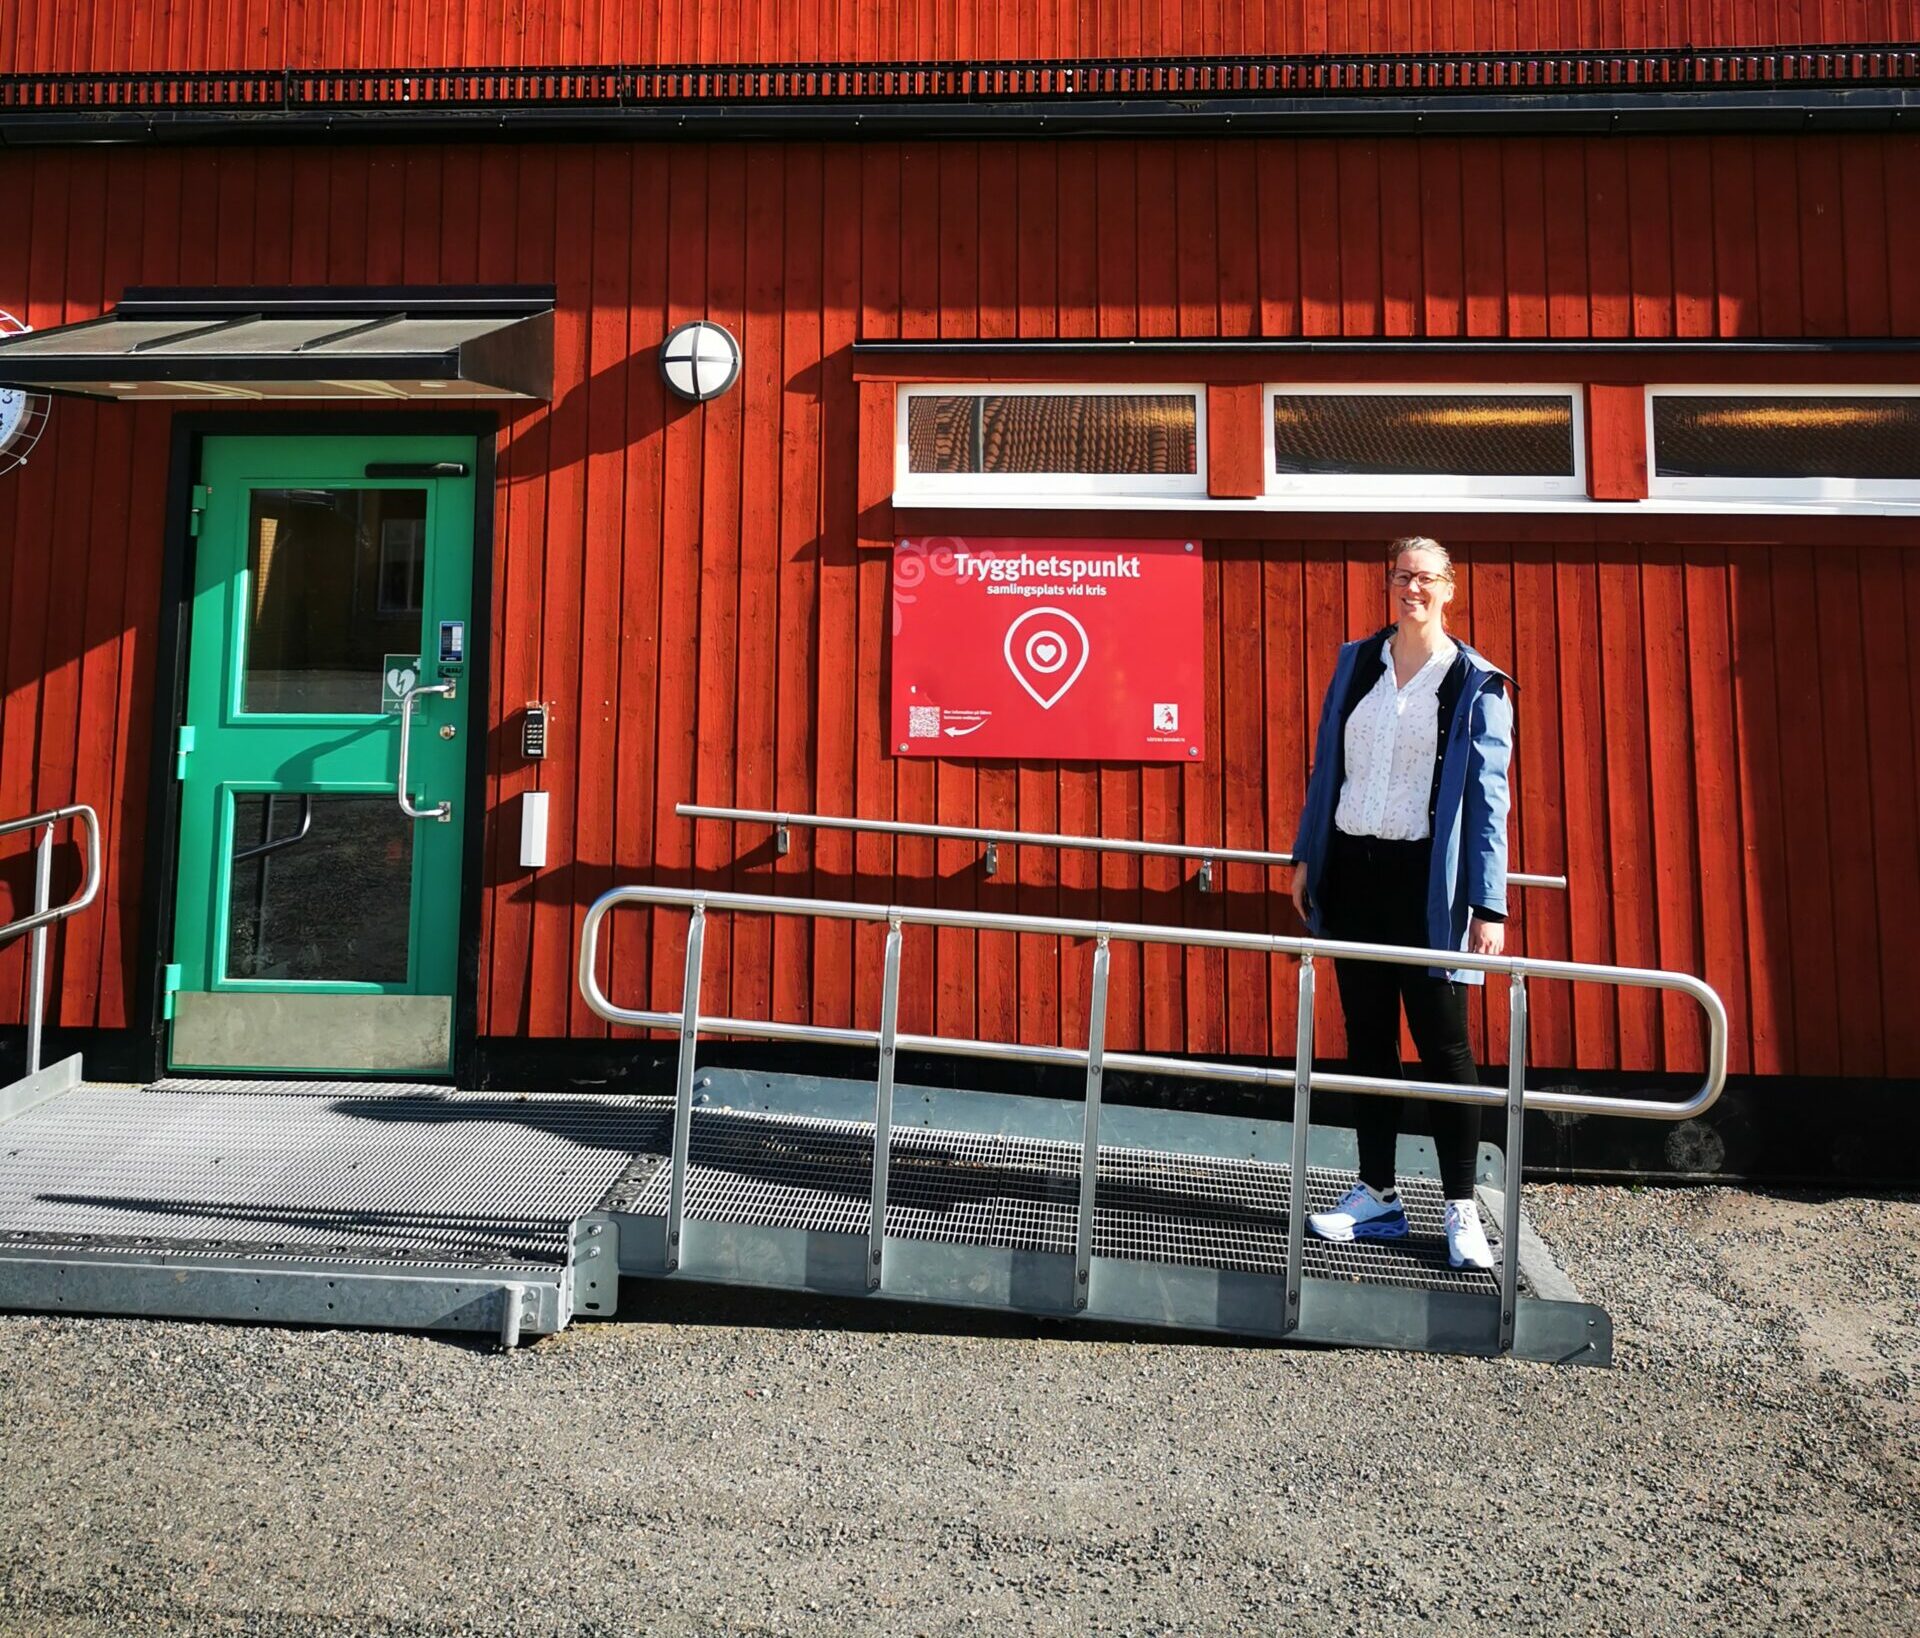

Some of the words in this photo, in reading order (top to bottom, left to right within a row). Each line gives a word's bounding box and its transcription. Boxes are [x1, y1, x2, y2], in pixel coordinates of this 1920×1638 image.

[954, 553, 1141, 582] Trygghetspunkt
[987, 583, 1065, 597] samlingsplats
[1066, 584, 1083, 596] vid
[1085, 584, 1107, 596] kris
